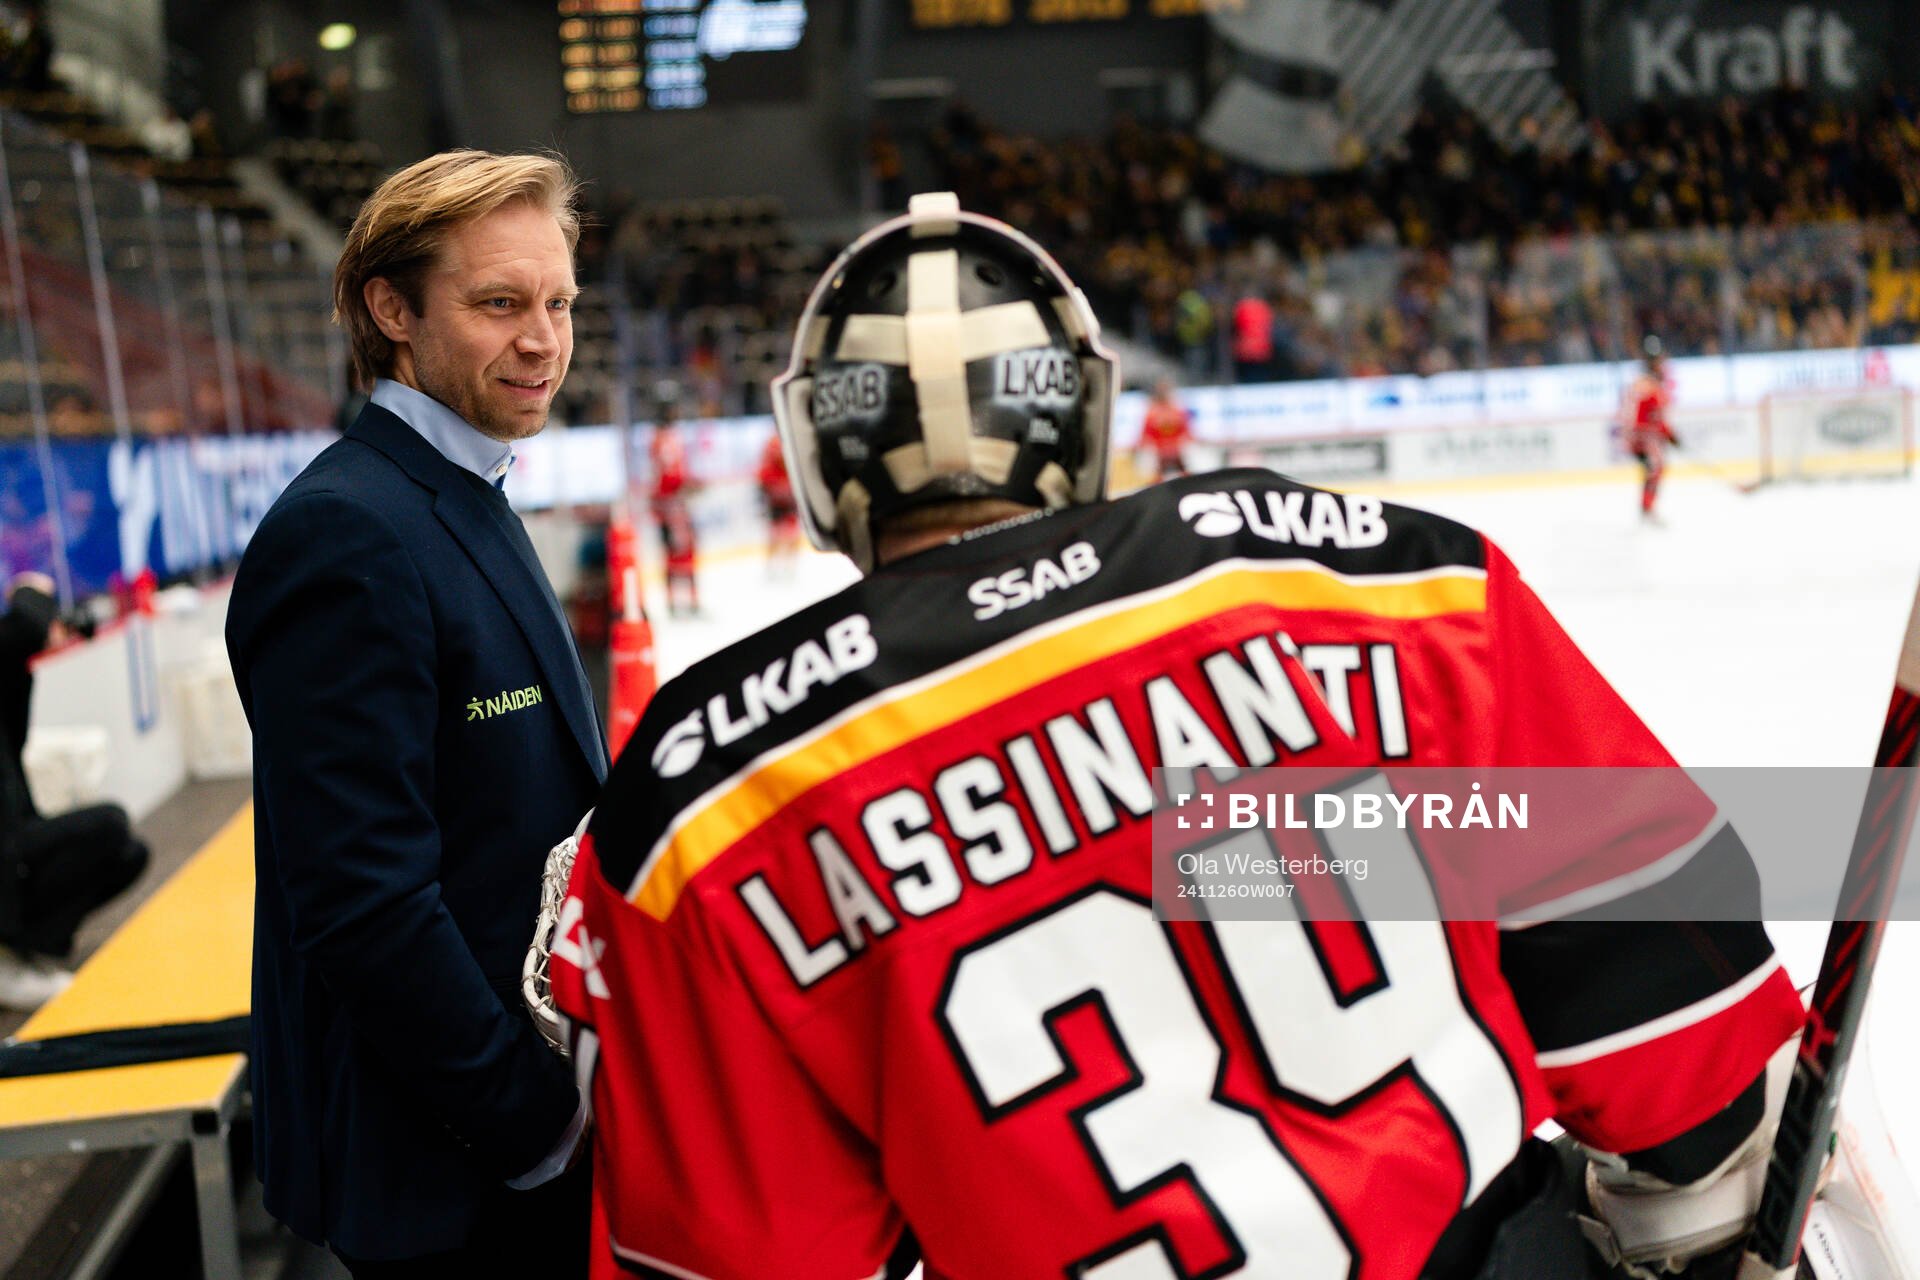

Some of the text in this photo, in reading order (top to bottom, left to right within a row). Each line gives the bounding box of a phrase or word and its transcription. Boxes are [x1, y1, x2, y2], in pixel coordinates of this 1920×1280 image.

[1629, 8, 1858, 95] Kraft
[815, 369, 883, 421] SSAB
[1002, 353, 1079, 397] LKAB
[1234, 489, 1388, 549] LKAB
[968, 541, 1101, 620] SSAB
[485, 685, 543, 718] NÅIDEN
[706, 613, 879, 748] LKAB
[738, 630, 1410, 988] LASSINANTI
[935, 769, 1524, 1280] 34
